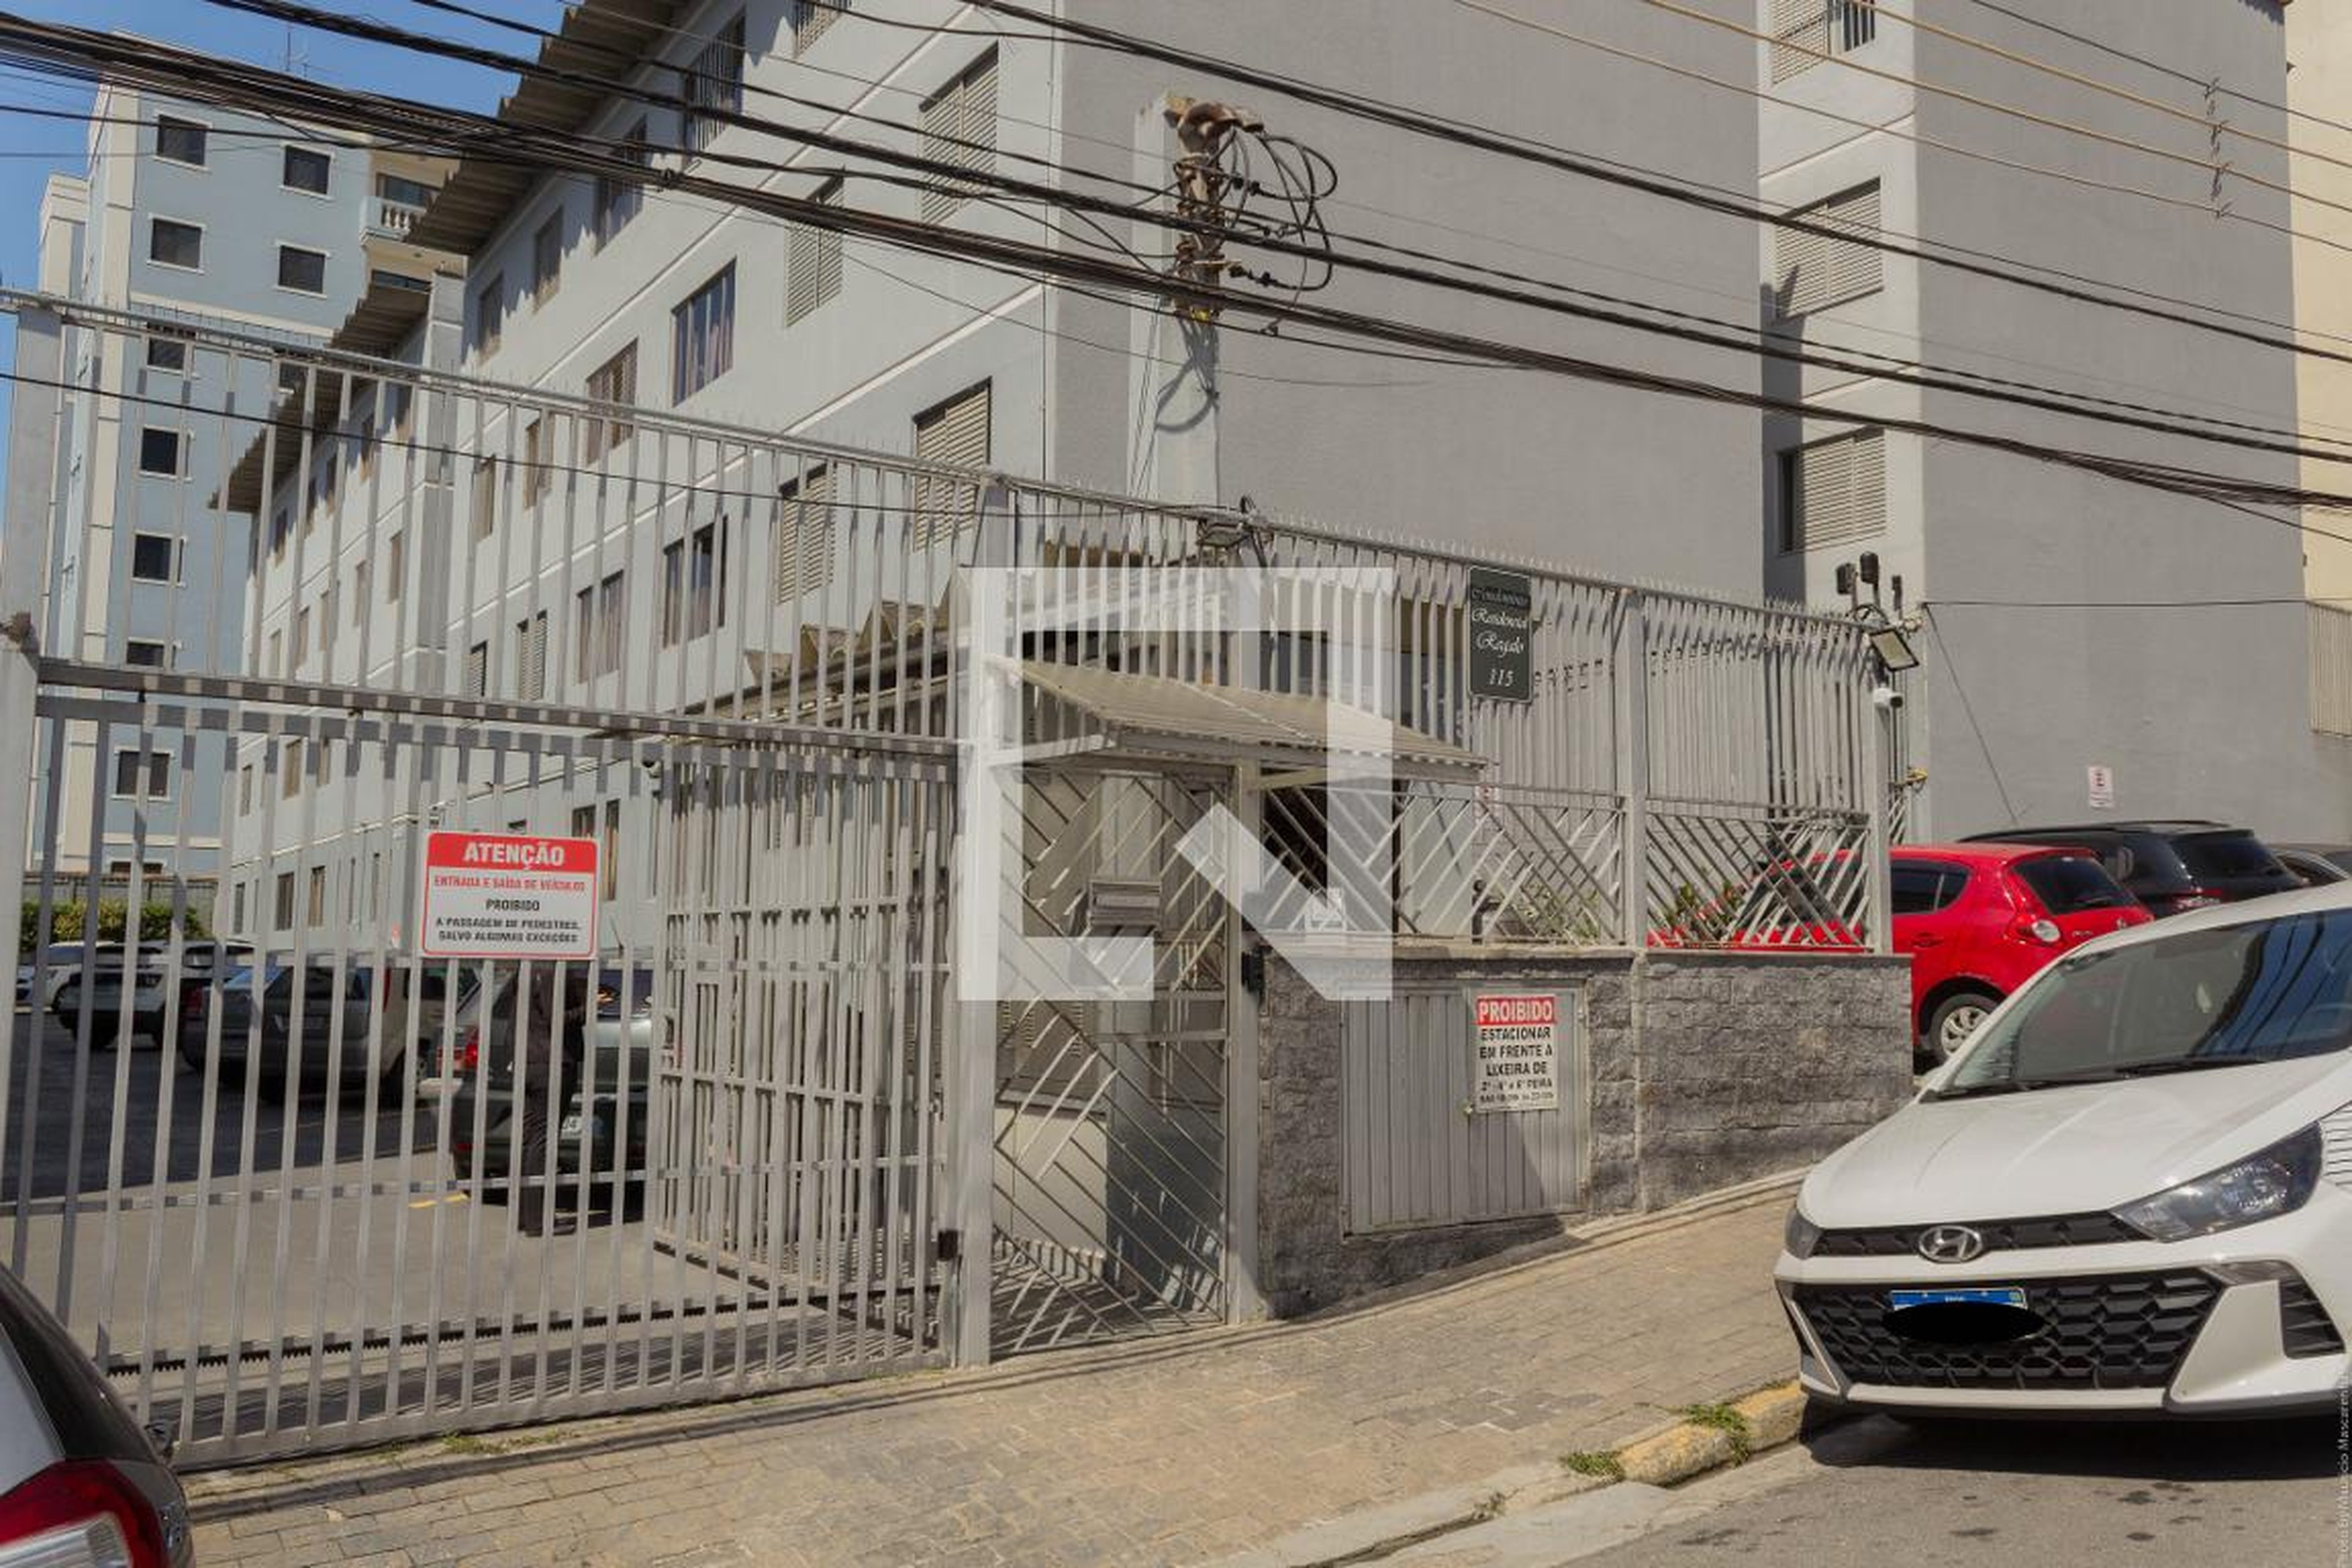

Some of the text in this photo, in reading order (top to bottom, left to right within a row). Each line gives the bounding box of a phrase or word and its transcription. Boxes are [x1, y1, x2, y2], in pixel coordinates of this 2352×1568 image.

[1490, 668, 1513, 687] 115
[464, 841, 565, 870] ATENÇÃO
[486, 899, 540, 911] PROIBIDO
[1478, 1000, 1553, 1022] PROIBIDO
[1481, 1027, 1551, 1041] ESTACIONAR
[1479, 1046, 1496, 1059] EM
[1499, 1044, 1542, 1058] FRENTE
[1485, 1061, 1547, 1076] LIXEIRA DE
